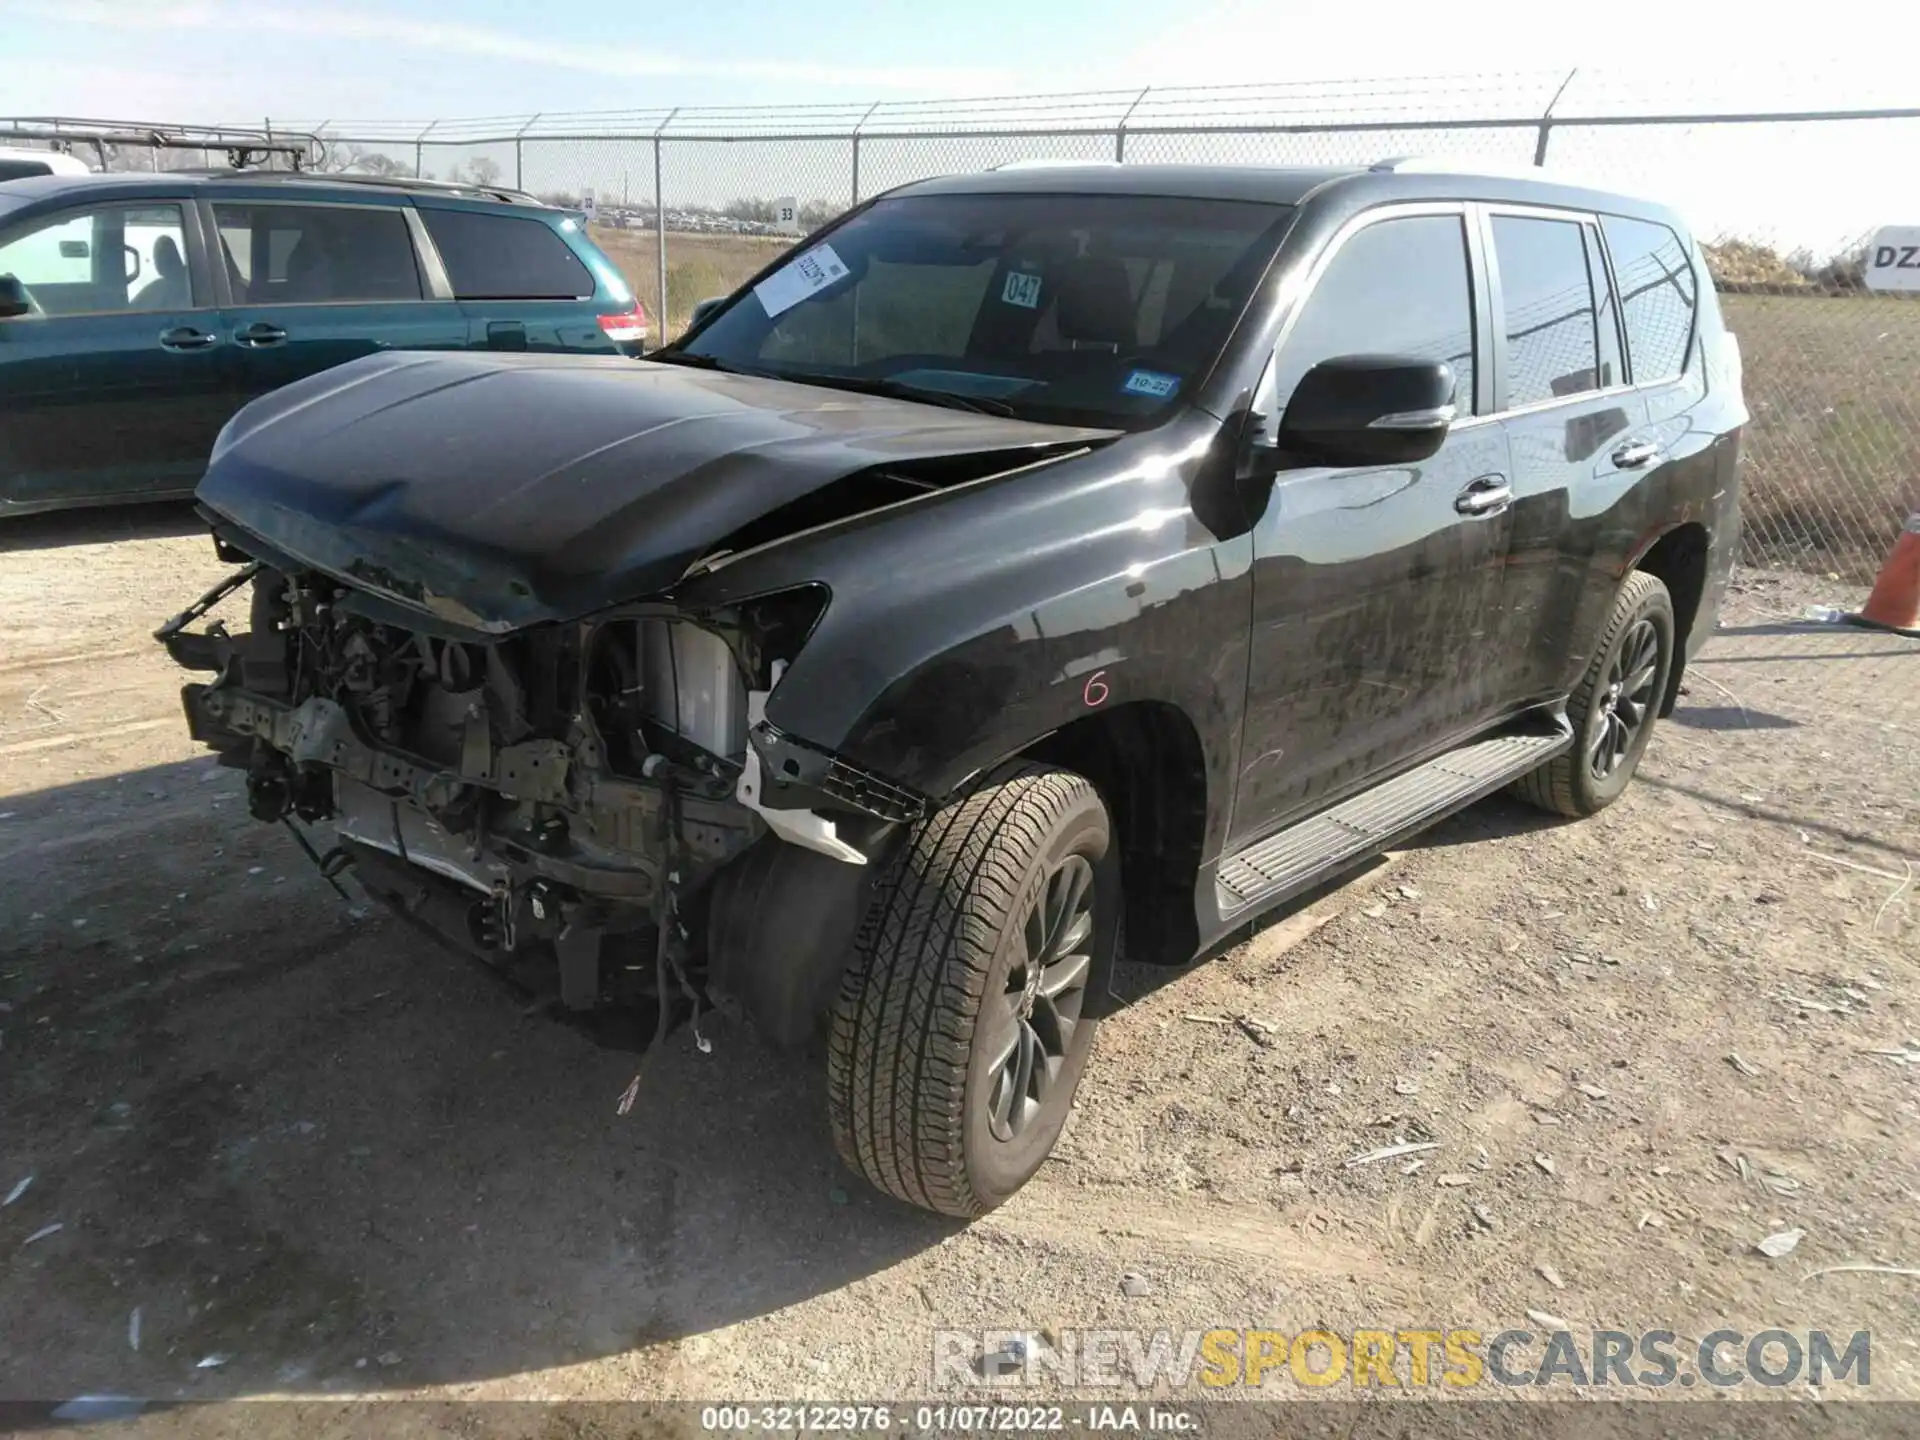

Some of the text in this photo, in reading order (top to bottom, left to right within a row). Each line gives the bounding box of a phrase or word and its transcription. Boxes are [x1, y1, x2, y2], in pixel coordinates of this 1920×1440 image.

[782, 207, 793, 221] 33
[1875, 245, 1920, 268] DZ
[1007, 274, 1039, 305] 047
[1084, 670, 1109, 707] 6
